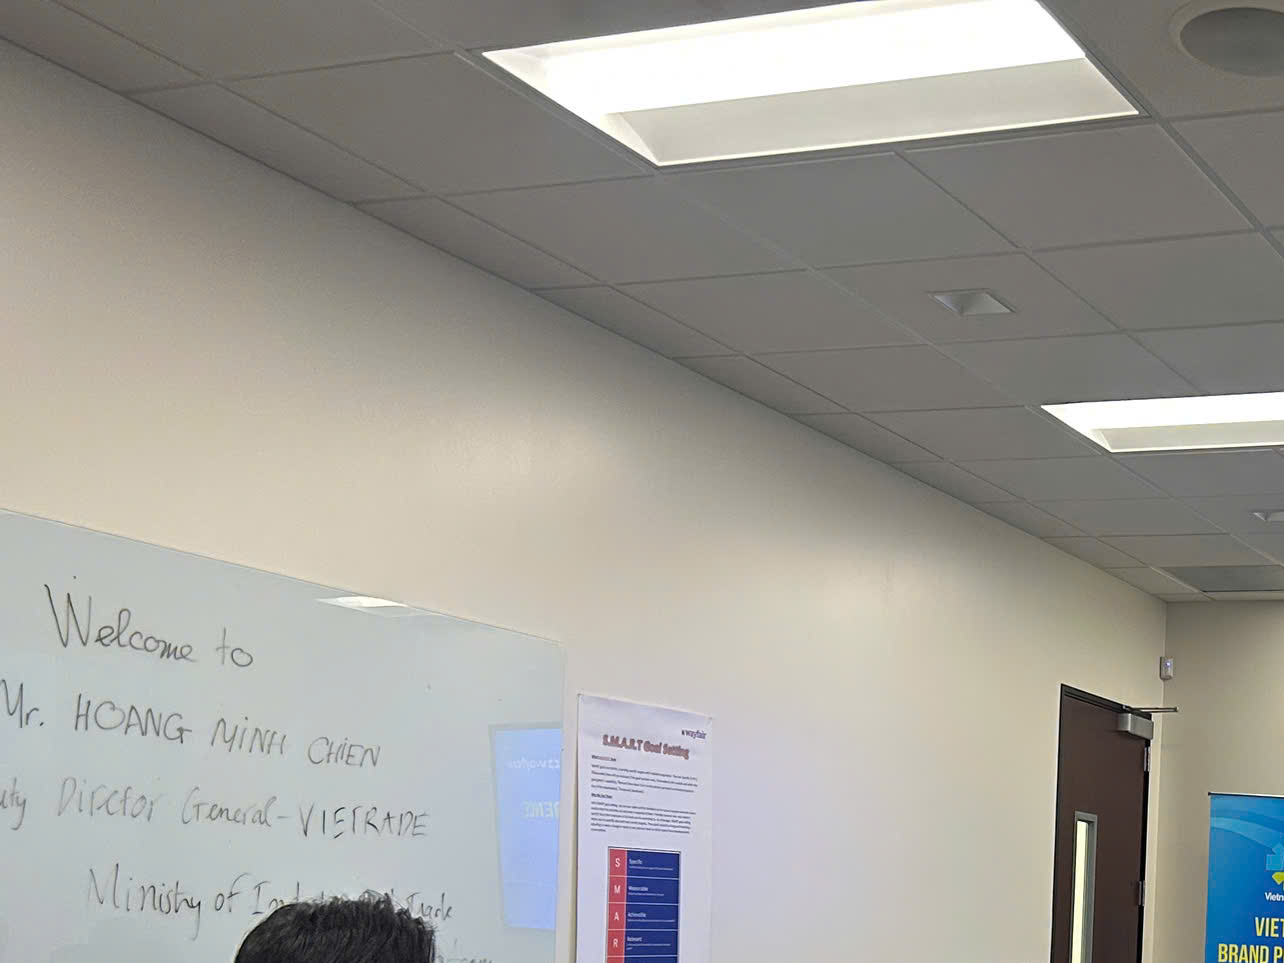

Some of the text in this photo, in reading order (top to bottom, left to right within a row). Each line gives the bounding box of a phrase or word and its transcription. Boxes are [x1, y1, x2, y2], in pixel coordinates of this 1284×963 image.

[44, 583, 254, 668] Welcome to
[74, 692, 193, 744] HOANG
[182, 786, 277, 828] General
